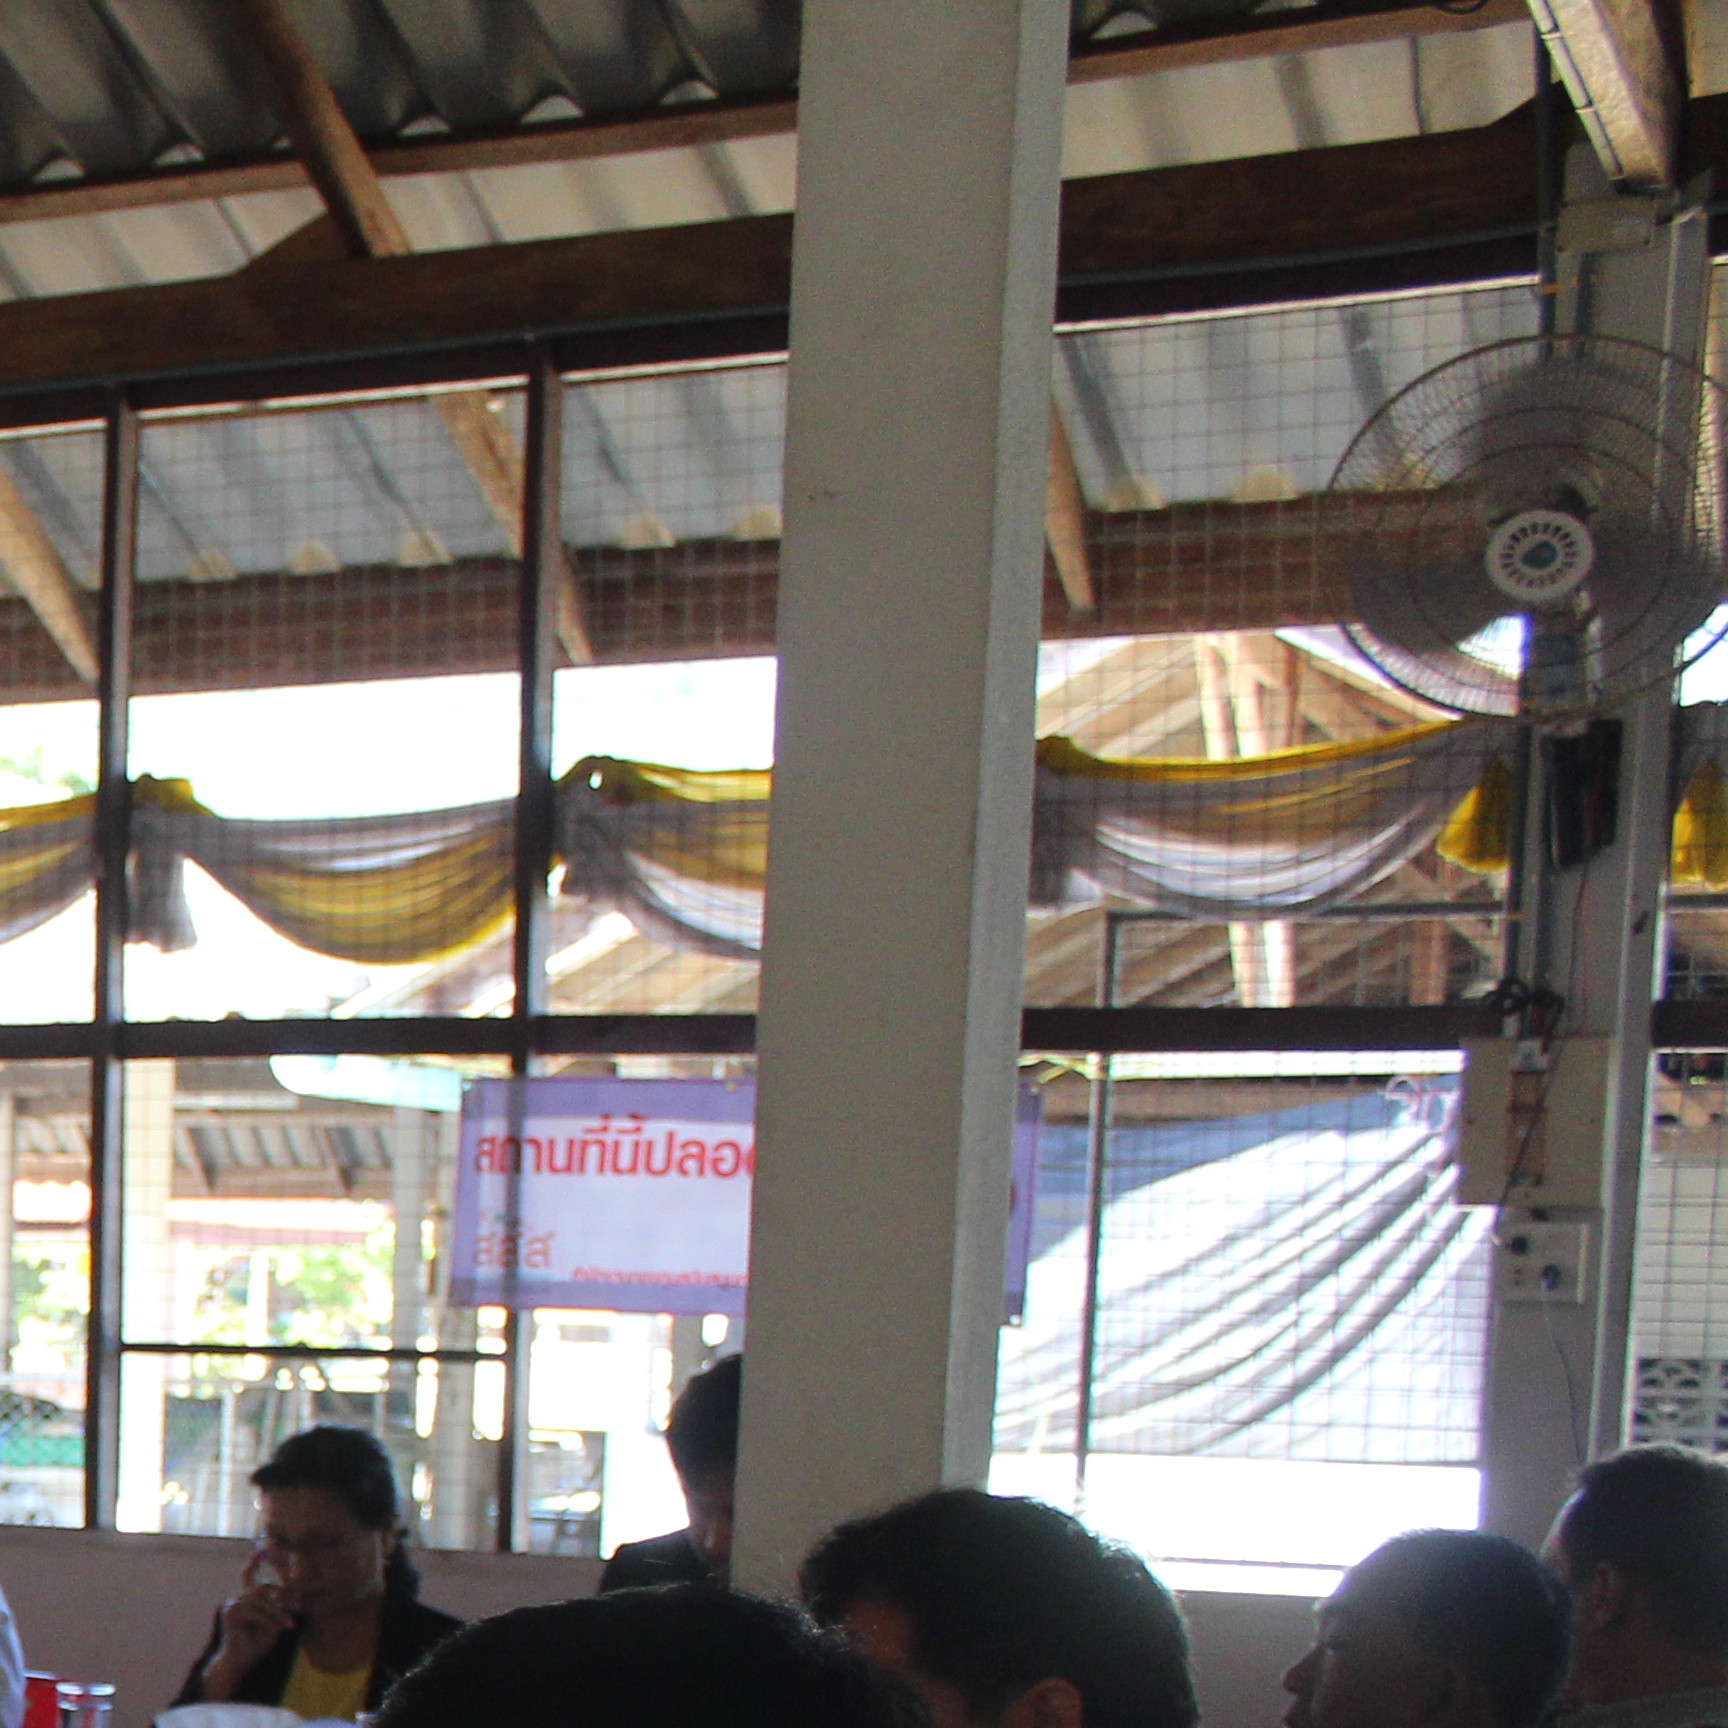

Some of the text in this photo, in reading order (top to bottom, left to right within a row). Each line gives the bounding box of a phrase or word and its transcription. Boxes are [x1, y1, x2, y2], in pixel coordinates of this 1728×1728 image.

[475, 1112, 754, 1178] สถานที่นี้ปลอ
